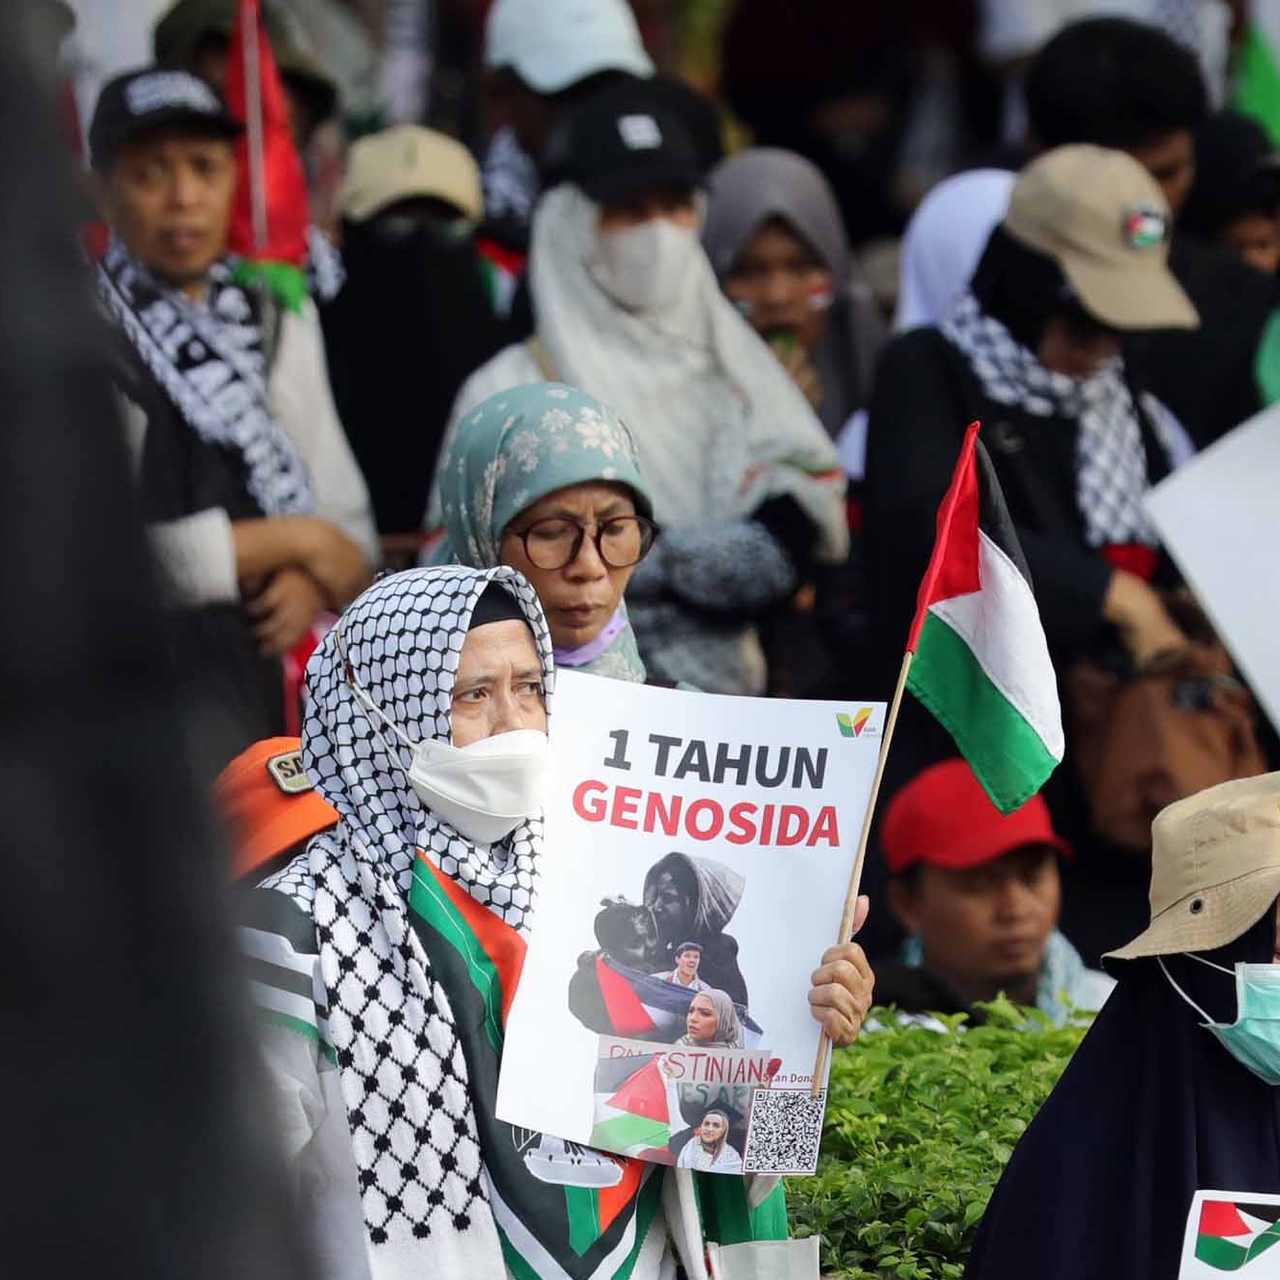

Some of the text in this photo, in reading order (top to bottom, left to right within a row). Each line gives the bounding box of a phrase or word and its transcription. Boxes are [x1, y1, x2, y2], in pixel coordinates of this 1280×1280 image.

[603, 729, 829, 790] 1 TAHUN
[572, 779, 841, 848] GENOSIDA
